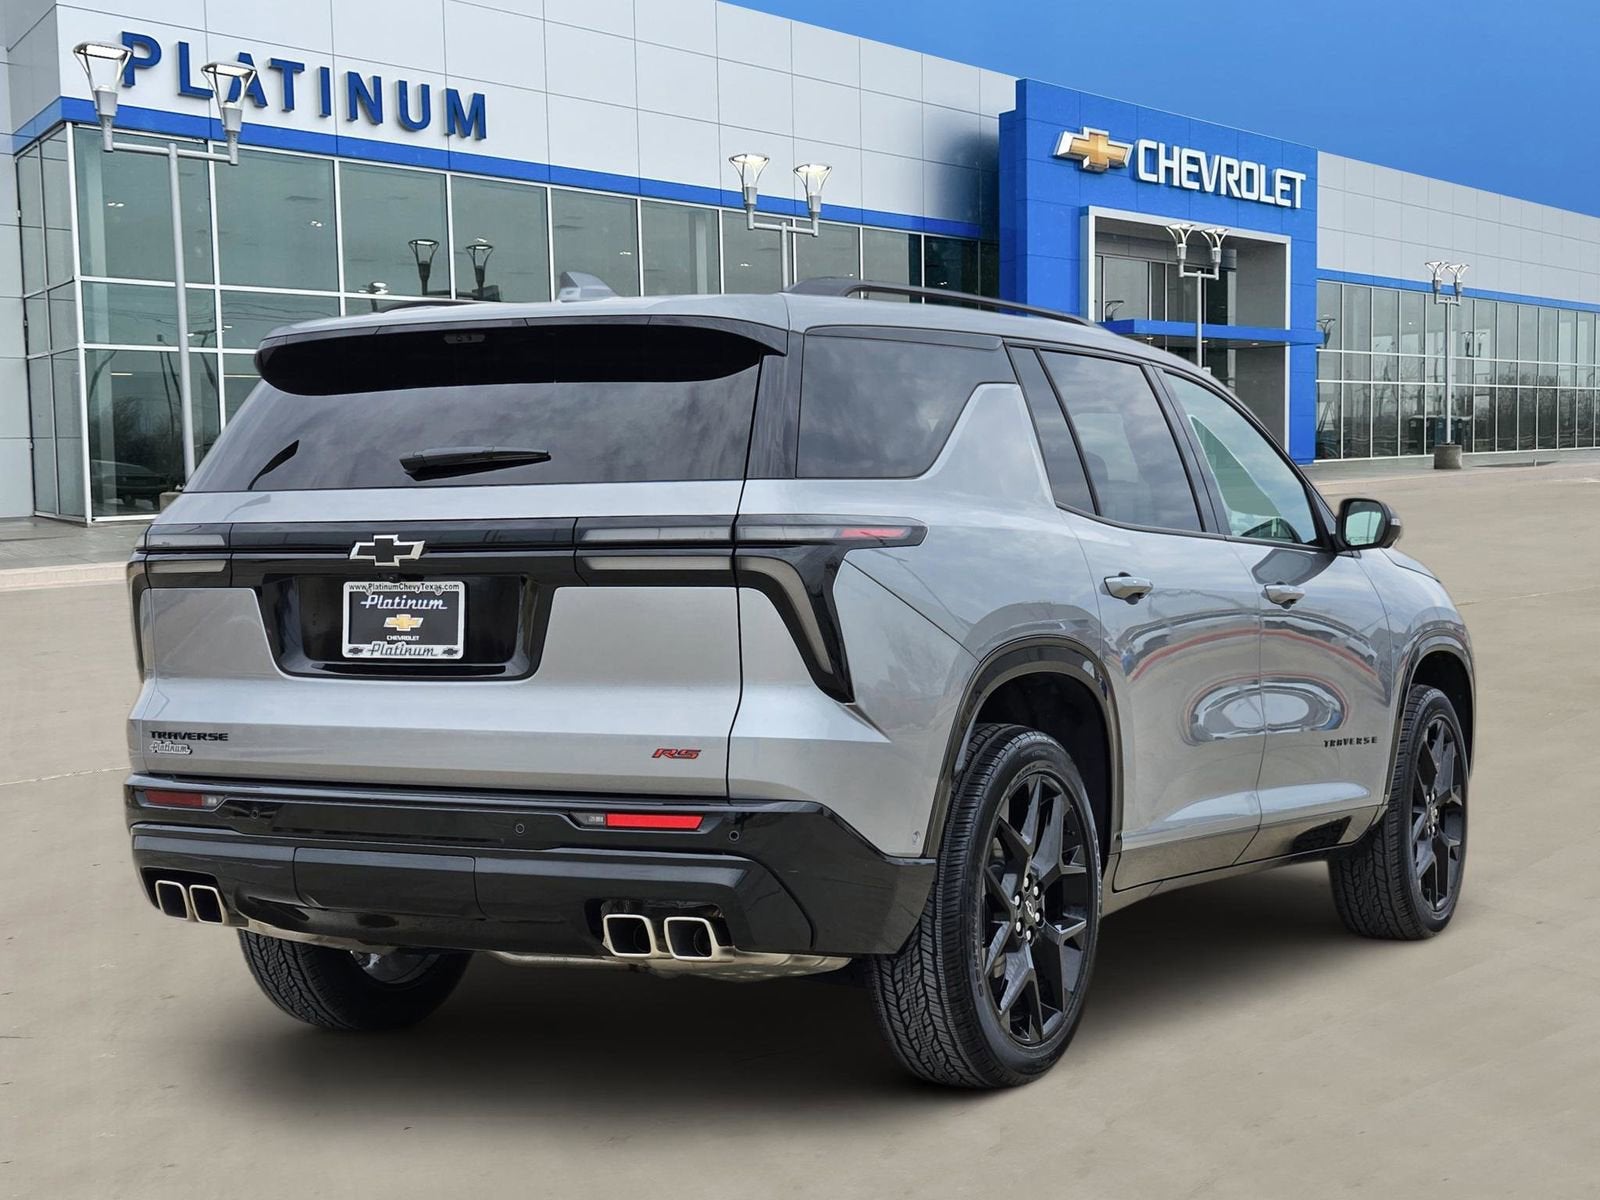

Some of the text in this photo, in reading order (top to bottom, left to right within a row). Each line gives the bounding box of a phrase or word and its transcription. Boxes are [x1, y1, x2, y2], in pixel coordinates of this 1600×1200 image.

[121, 31, 487, 140] PLATINUM
[1137, 139, 1306, 208] CHEVROLET
[349, 583, 460, 592] www.PlatinumChevyTexas.com
[360, 595, 448, 609] Platinum
[367, 642, 438, 656] Platinum
[150, 731, 229, 741] TRAVERSE
[1323, 736, 1378, 748] TRAVERSE
[149, 740, 193, 755] Platinum
[651, 748, 702, 759] RS
